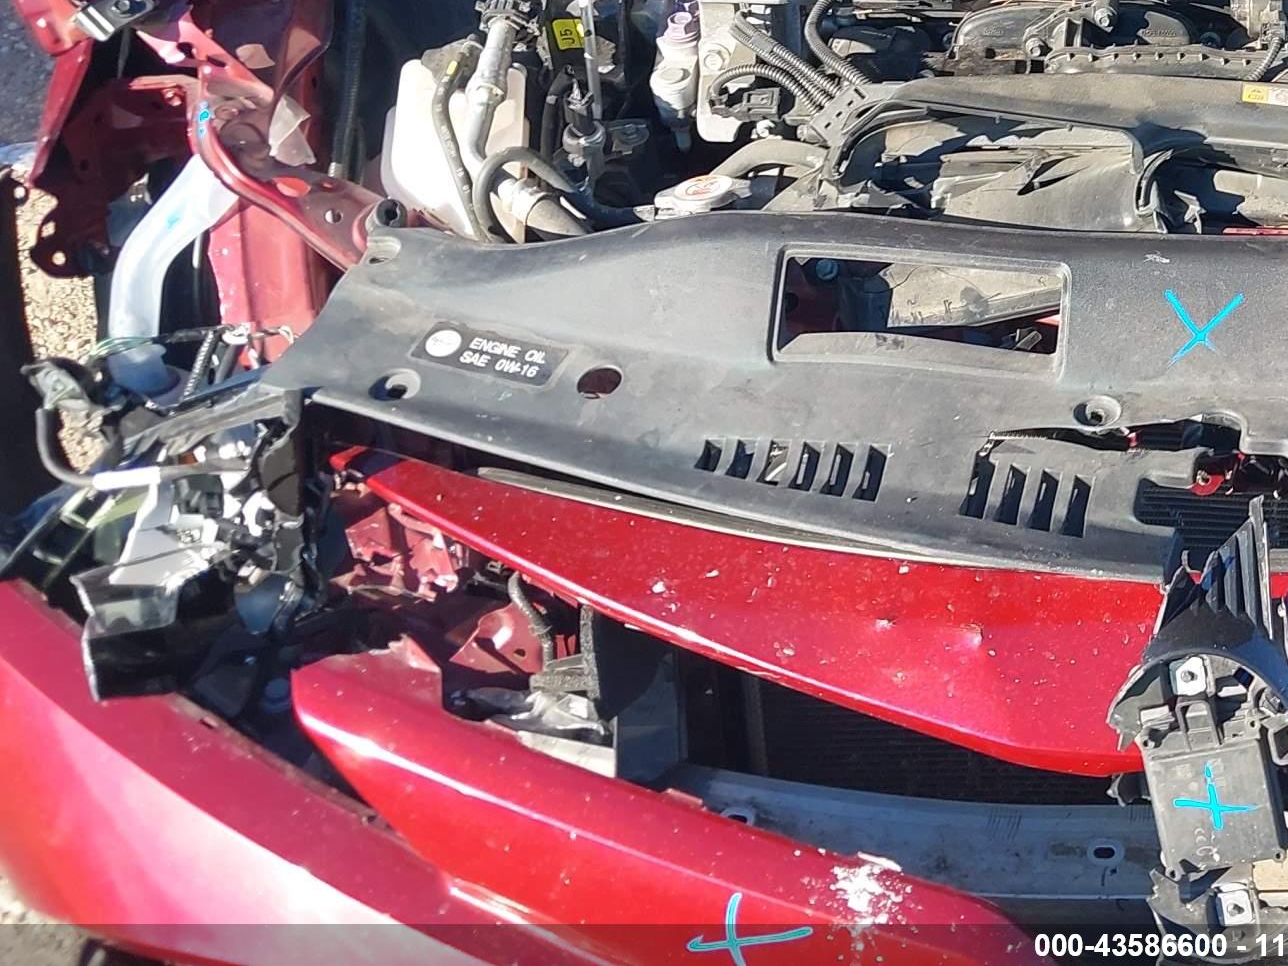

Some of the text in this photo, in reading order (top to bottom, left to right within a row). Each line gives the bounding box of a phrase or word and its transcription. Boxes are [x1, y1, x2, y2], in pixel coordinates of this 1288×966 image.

[559, 27, 576, 45] J5
[459, 350, 540, 378] SAE 0W-16
[469, 337, 522, 358] ENGINE
[524, 349, 546, 364] OIL
